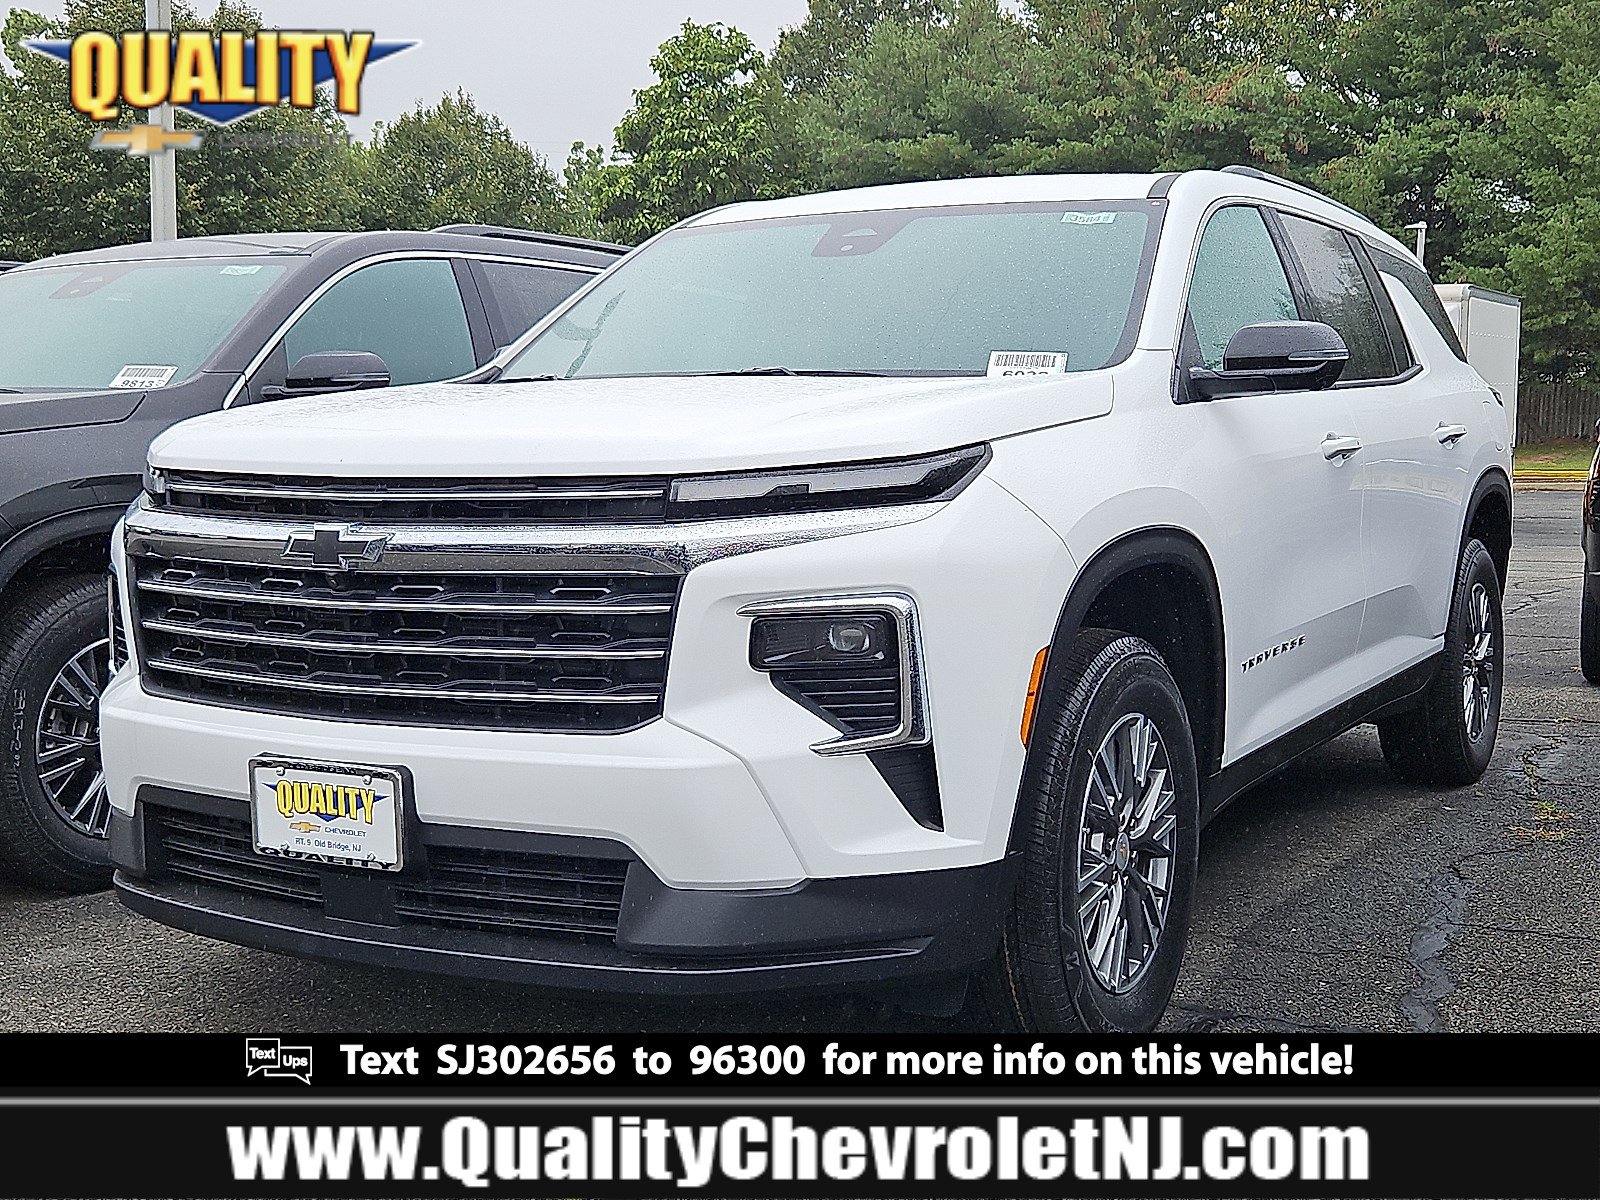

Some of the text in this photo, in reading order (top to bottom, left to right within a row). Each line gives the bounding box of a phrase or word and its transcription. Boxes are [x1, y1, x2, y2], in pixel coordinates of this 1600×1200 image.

[1241, 634, 1306, 674] TRAVERSE
[276, 779, 376, 825] QUALITY
[314, 839, 326, 848] Old
[327, 840, 352, 853] Bridge,
[352, 843, 362, 852] NJ
[324, 827, 367, 838] CHEVROLET
